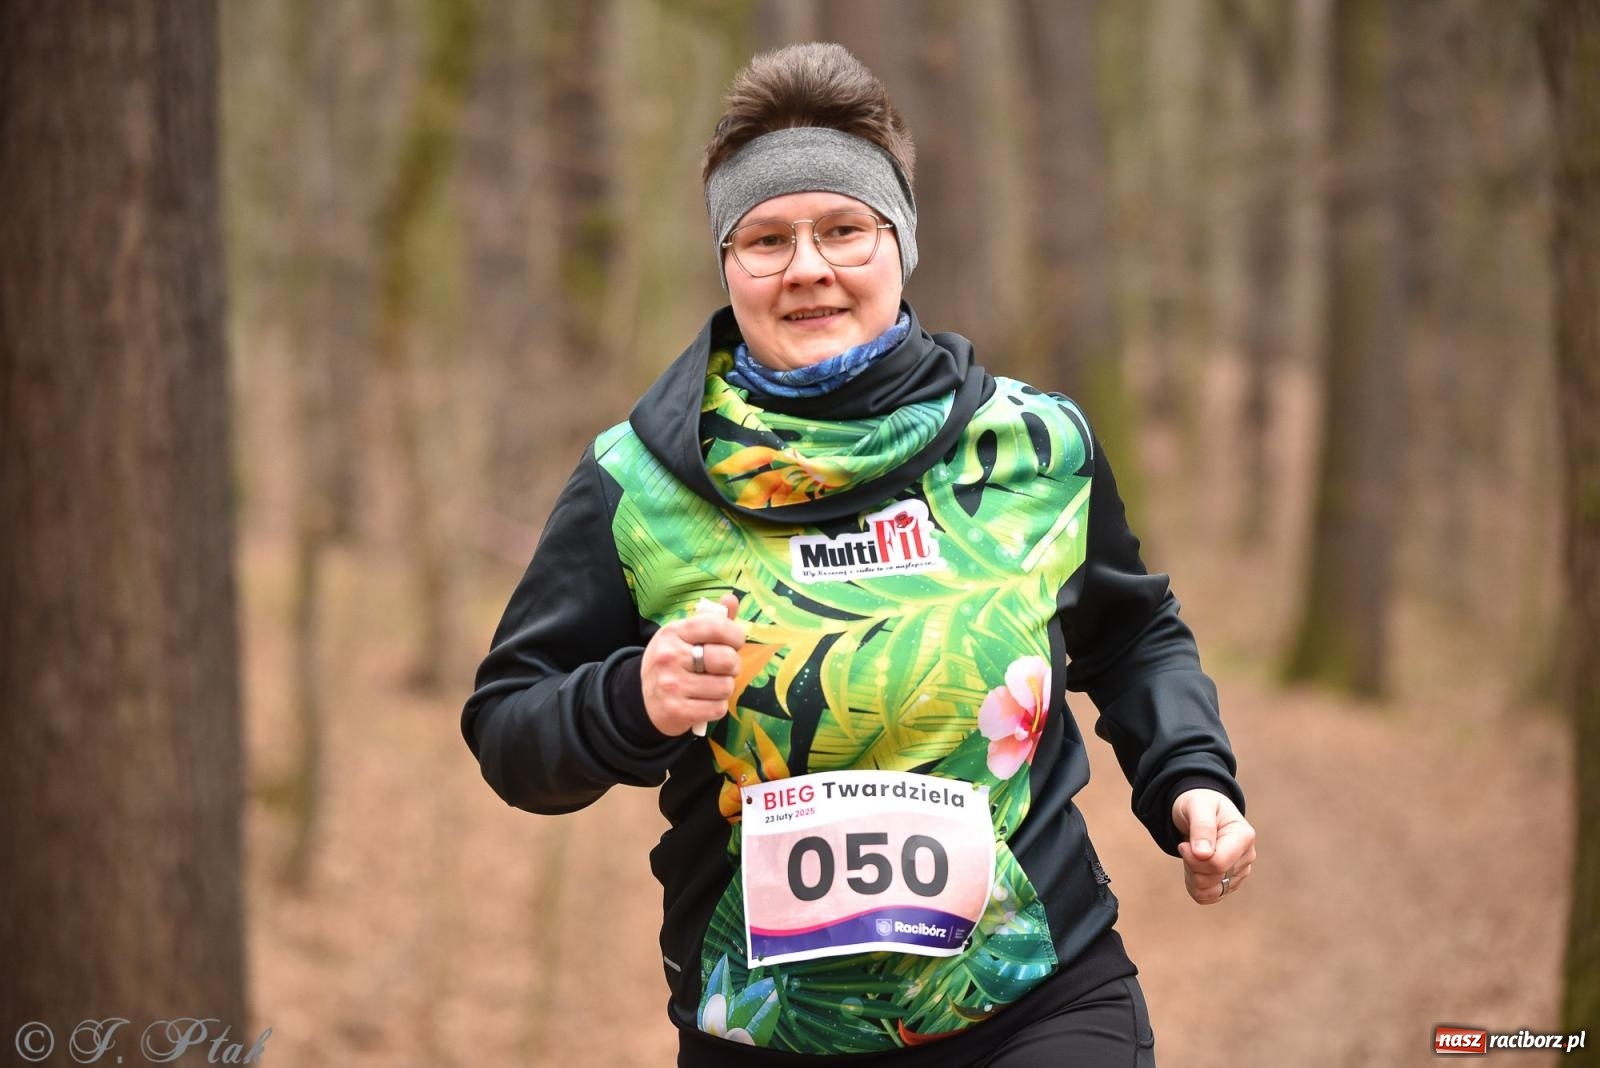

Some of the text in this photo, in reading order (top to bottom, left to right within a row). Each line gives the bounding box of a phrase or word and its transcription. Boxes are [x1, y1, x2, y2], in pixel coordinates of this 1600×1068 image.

[764, 781, 965, 811] BIEG Twardziela
[765, 807, 816, 823] 23 luty 2025
[787, 832, 949, 902] 050
[894, 920, 947, 938] Racibórz
